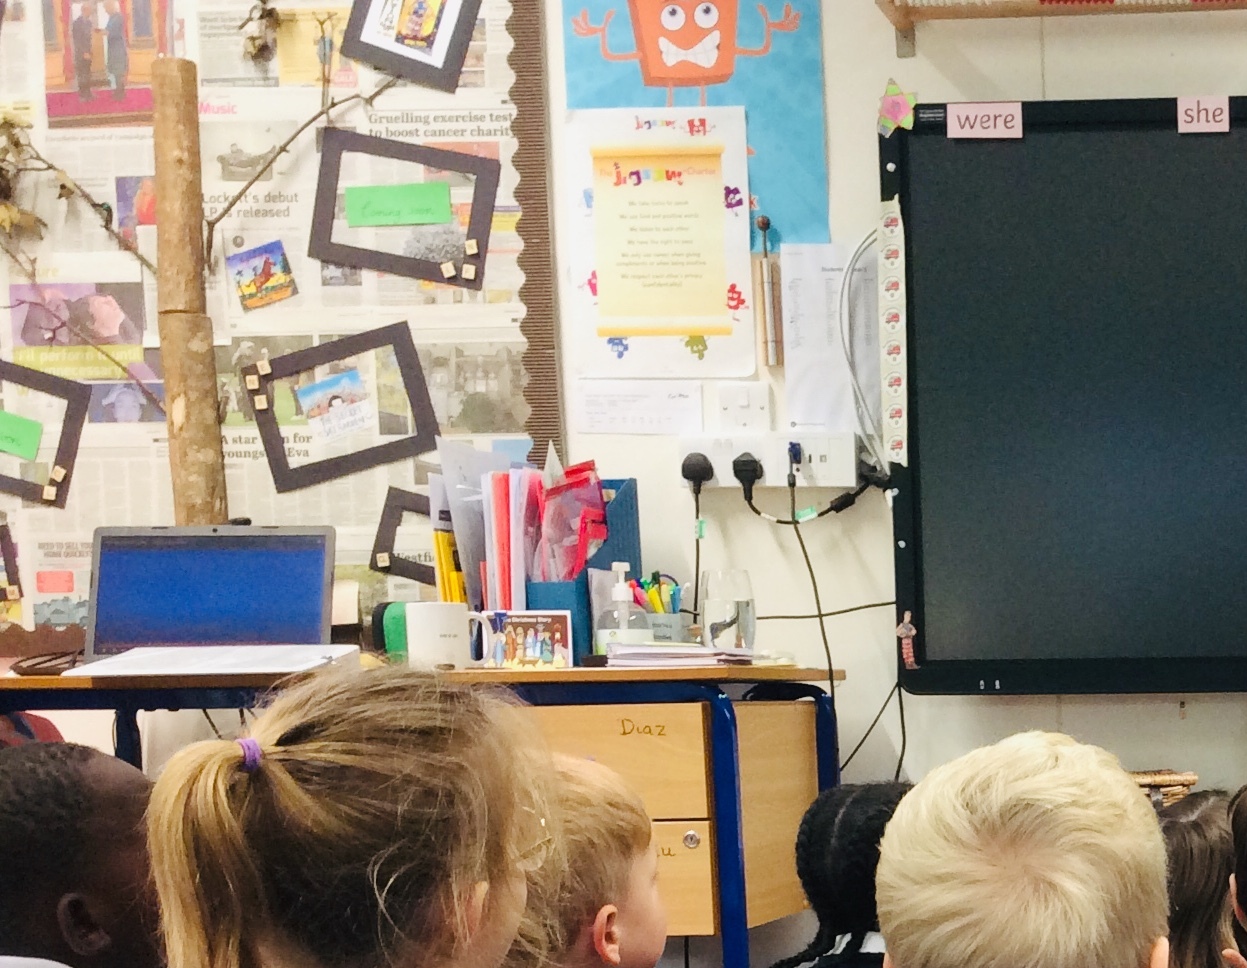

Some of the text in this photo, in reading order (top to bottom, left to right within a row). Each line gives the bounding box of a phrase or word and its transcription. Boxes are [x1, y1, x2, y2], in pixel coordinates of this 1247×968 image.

[198, 101, 238, 115] Music
[1182, 101, 1225, 125] she
[433, 111, 490, 124] exercise
[956, 110, 1016, 131] were
[384, 125, 421, 138] boost
[422, 128, 467, 138] cancer
[263, 191, 299, 204] debut
[236, 206, 291, 218] released
[231, 435, 258, 446] star
[291, 434, 313, 444] for
[287, 449, 310, 458] Eva
[619, 718, 667, 737] Diaz
